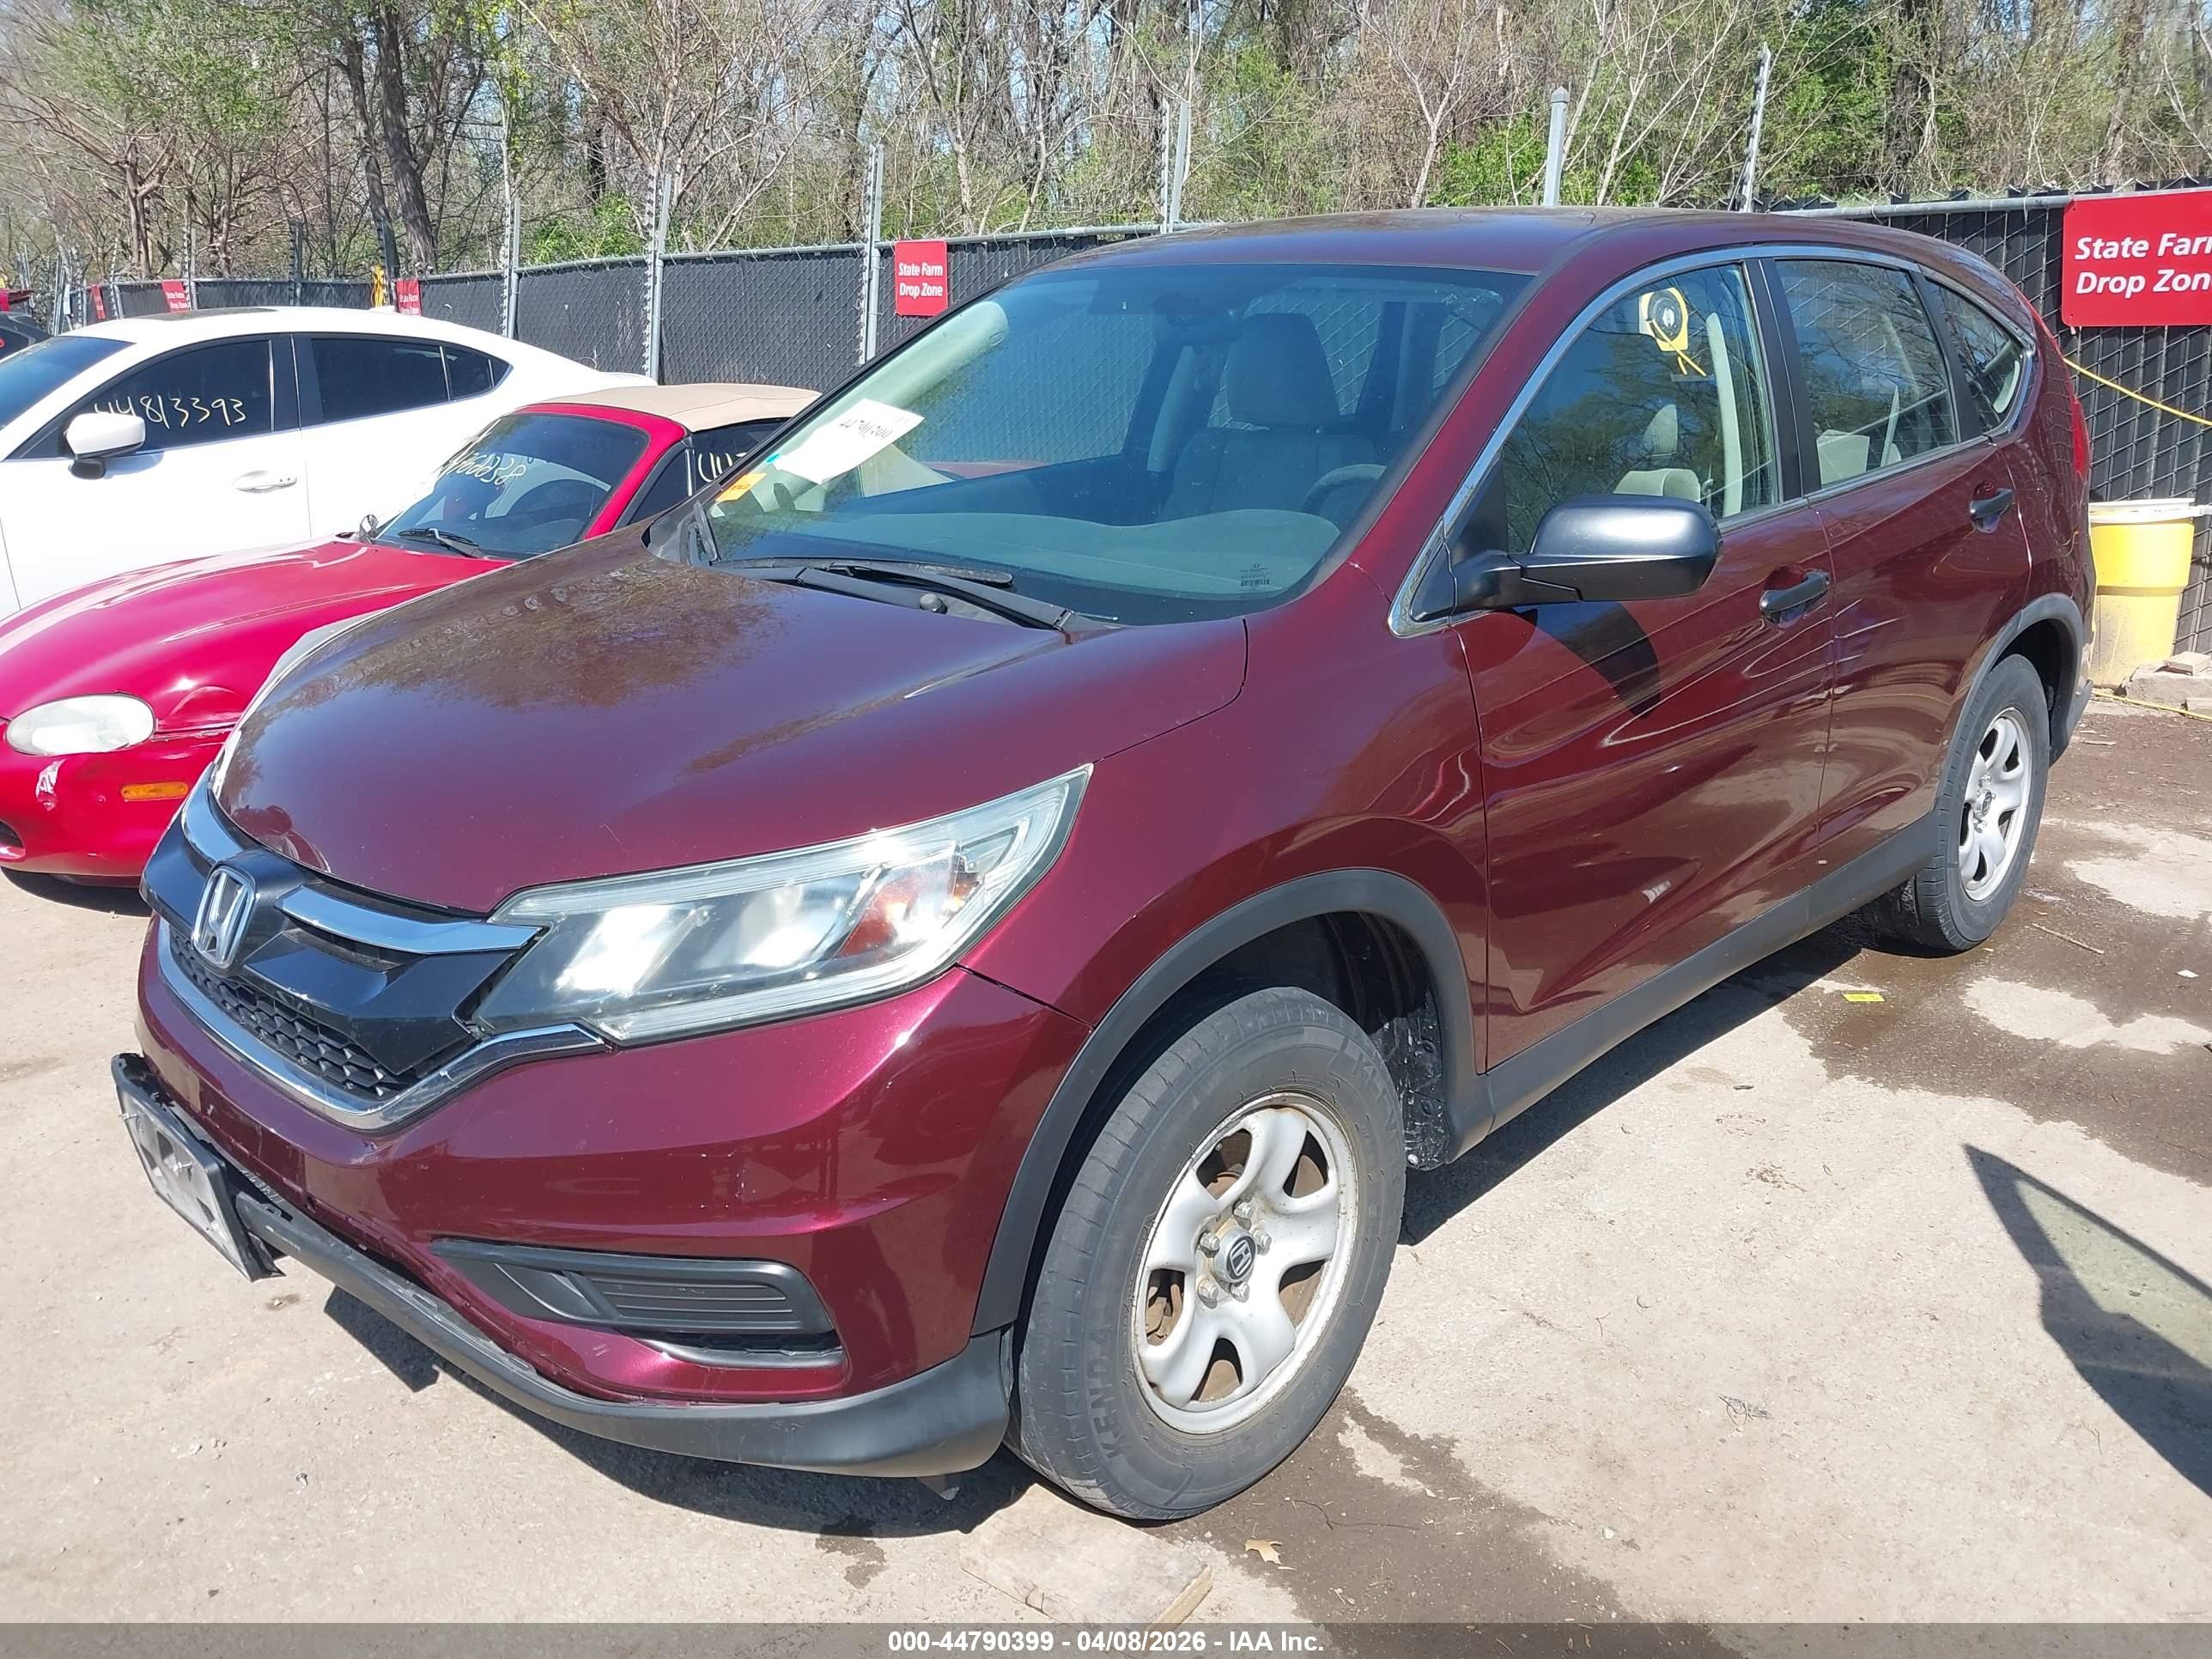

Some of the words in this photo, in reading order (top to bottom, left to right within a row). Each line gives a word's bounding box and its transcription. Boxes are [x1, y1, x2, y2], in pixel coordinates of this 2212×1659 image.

[2074, 236, 2149, 260] State
[2157, 233, 2212, 257] Far
[898, 262, 921, 276] State
[921, 261, 944, 276] Farm
[899, 282, 921, 300] Drop
[921, 282, 944, 297] Zone
[2075, 271, 2146, 299] Drop
[2152, 269, 2212, 292] Zon
